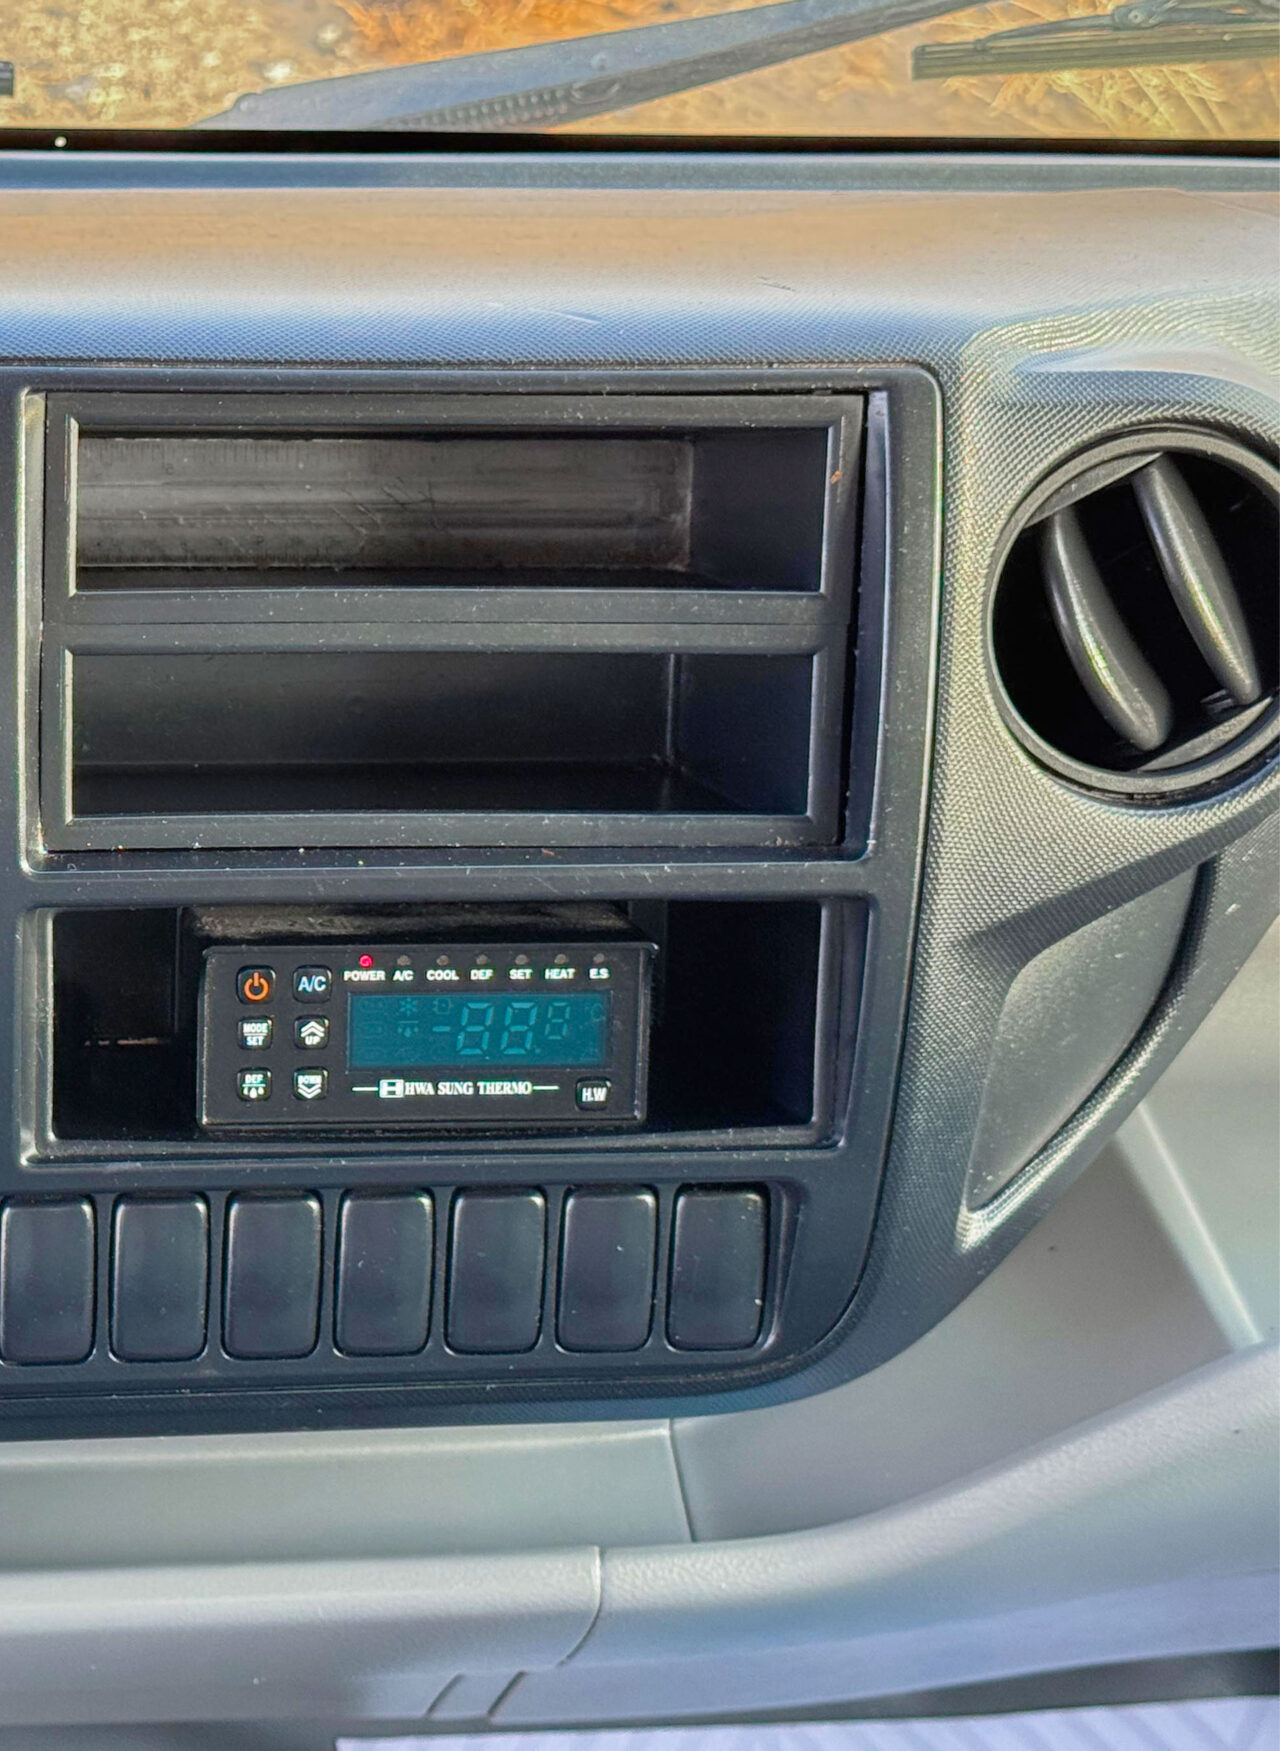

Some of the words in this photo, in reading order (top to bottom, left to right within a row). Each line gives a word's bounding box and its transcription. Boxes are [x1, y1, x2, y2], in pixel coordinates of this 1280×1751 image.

[343, 970, 386, 981] POWER
[392, 970, 414, 982] A/C
[426, 969, 460, 981] COOL
[470, 969, 494, 980] DEF
[509, 969, 534, 980] SET
[544, 968, 576, 980] HEAT
[298, 975, 327, 992] A/C
[243, 1023, 269, 1033] MODE
[246, 1036, 265, 1046] SET
[304, 1036, 322, 1045] UP
[245, 1074, 264, 1084] DEF
[437, 1081, 474, 1095] SUNG
[477, 1081, 532, 1095] THERMO
